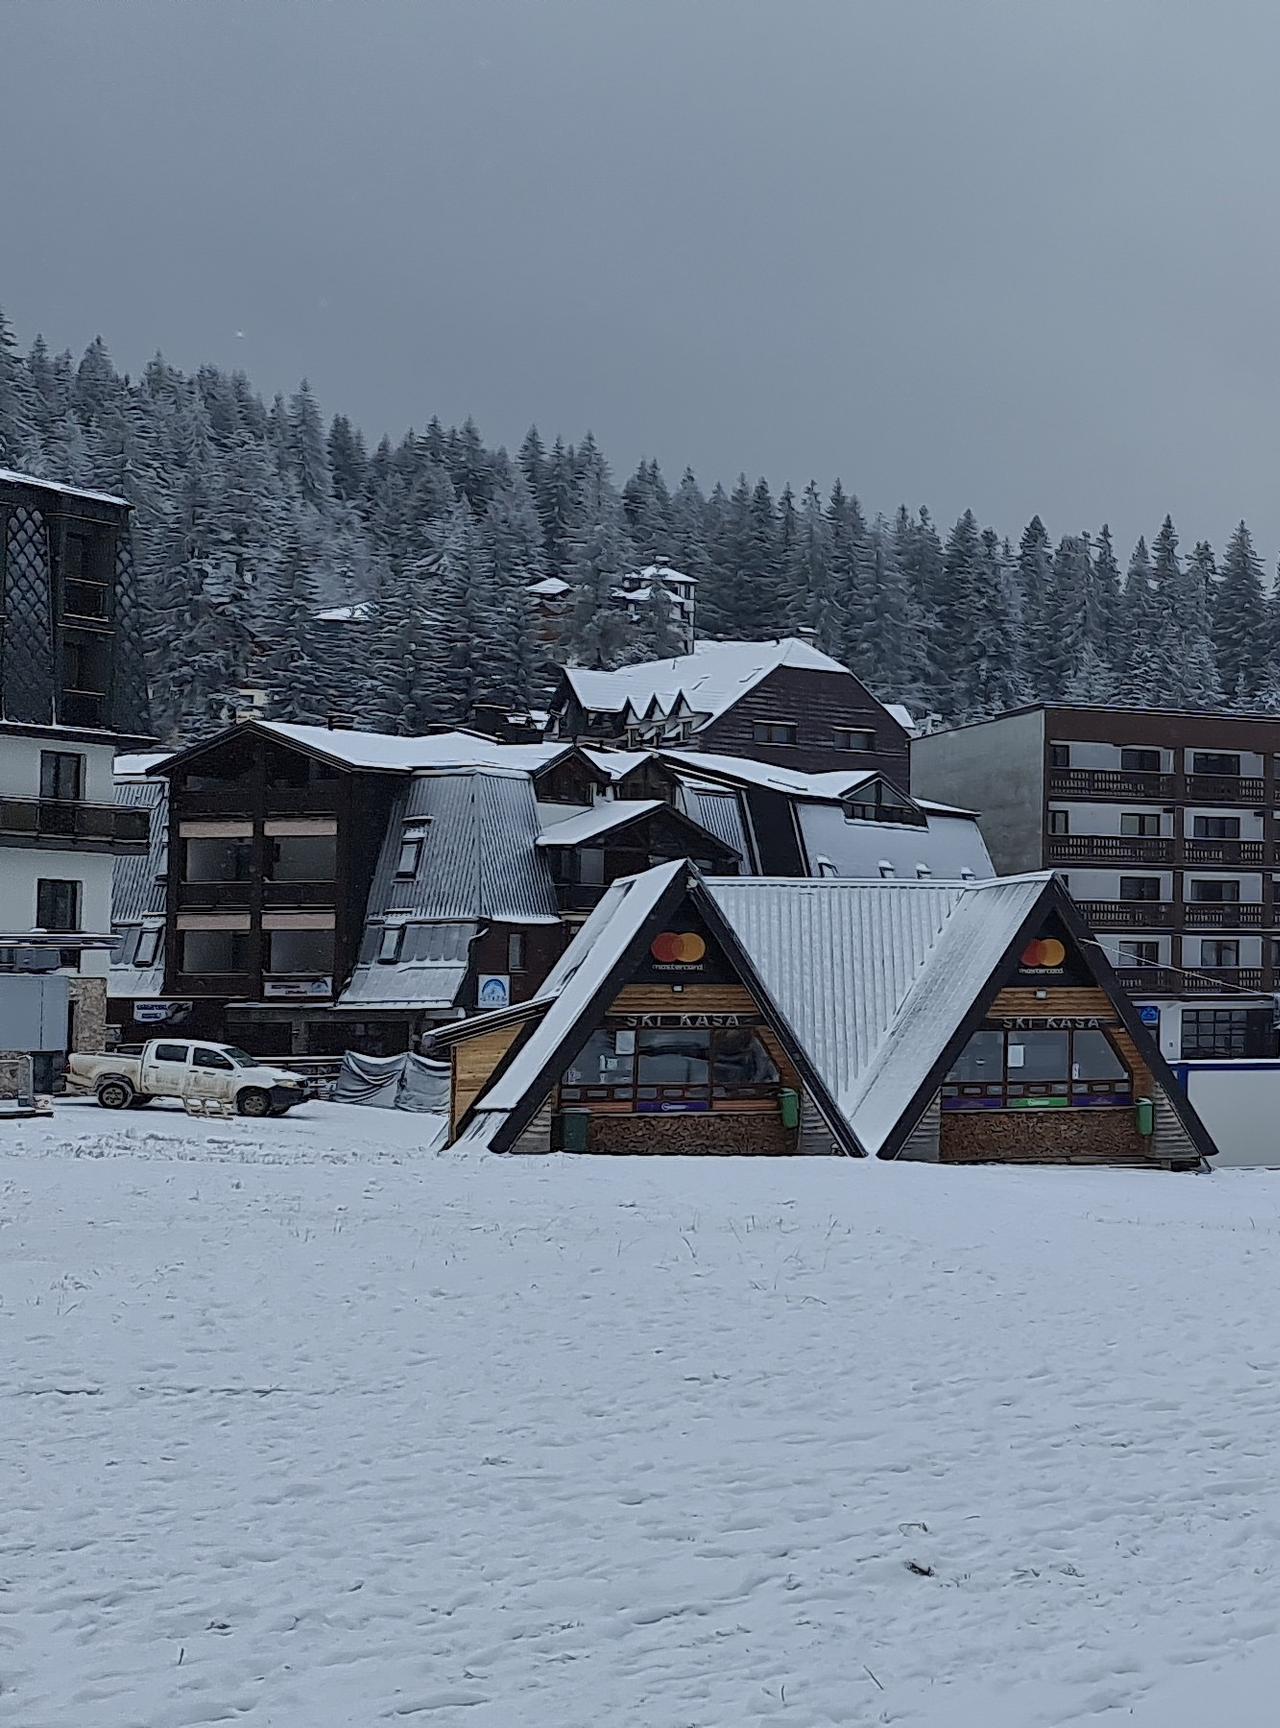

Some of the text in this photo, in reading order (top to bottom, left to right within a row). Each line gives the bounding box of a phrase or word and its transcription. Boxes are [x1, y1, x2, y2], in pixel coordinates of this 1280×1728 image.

[627, 1015, 739, 1027] SKI KASA
[1002, 1018, 1100, 1029] SKI KASA
